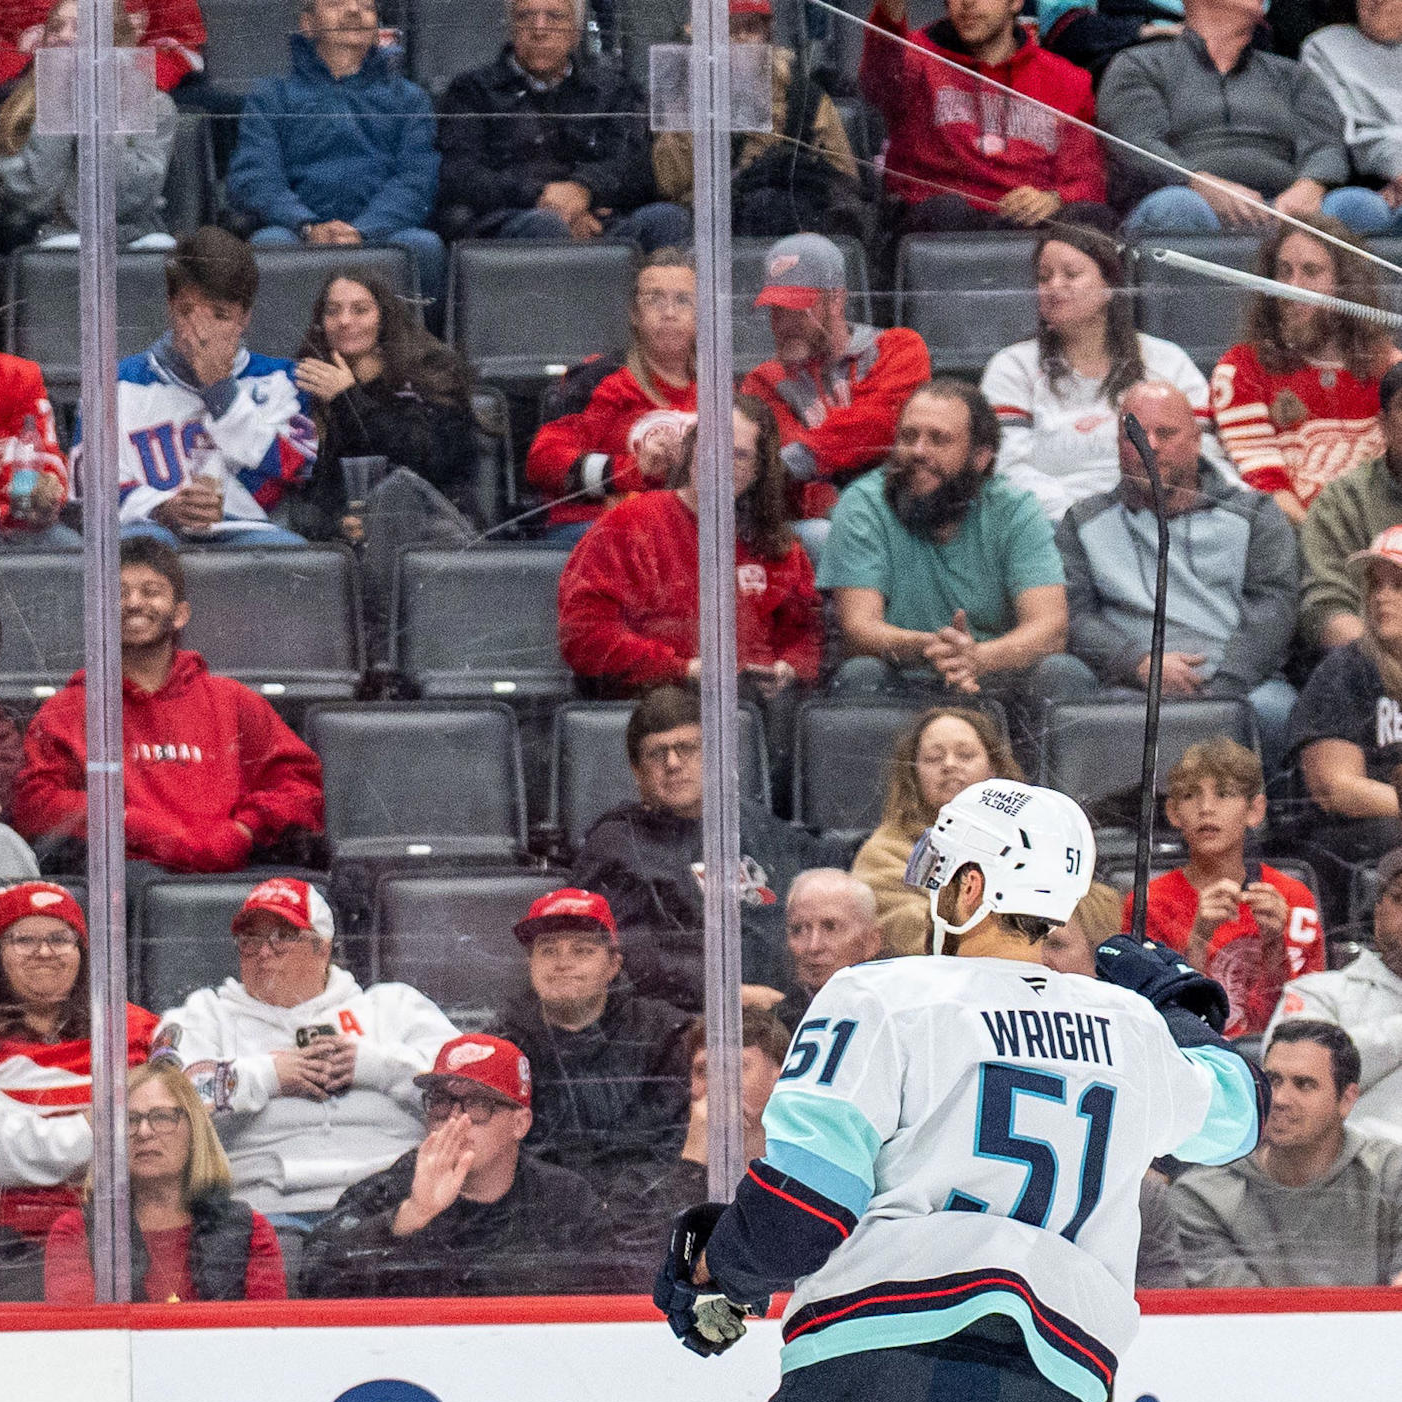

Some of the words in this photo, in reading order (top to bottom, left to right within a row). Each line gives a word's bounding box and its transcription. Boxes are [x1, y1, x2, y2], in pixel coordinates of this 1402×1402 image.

[1065, 847, 1082, 876] 51
[1288, 906, 1318, 944] C
[337, 1009, 364, 1037] A
[981, 1009, 1115, 1068] WRIGHT
[779, 1017, 859, 1087] 51
[943, 1061, 1119, 1246] 51
